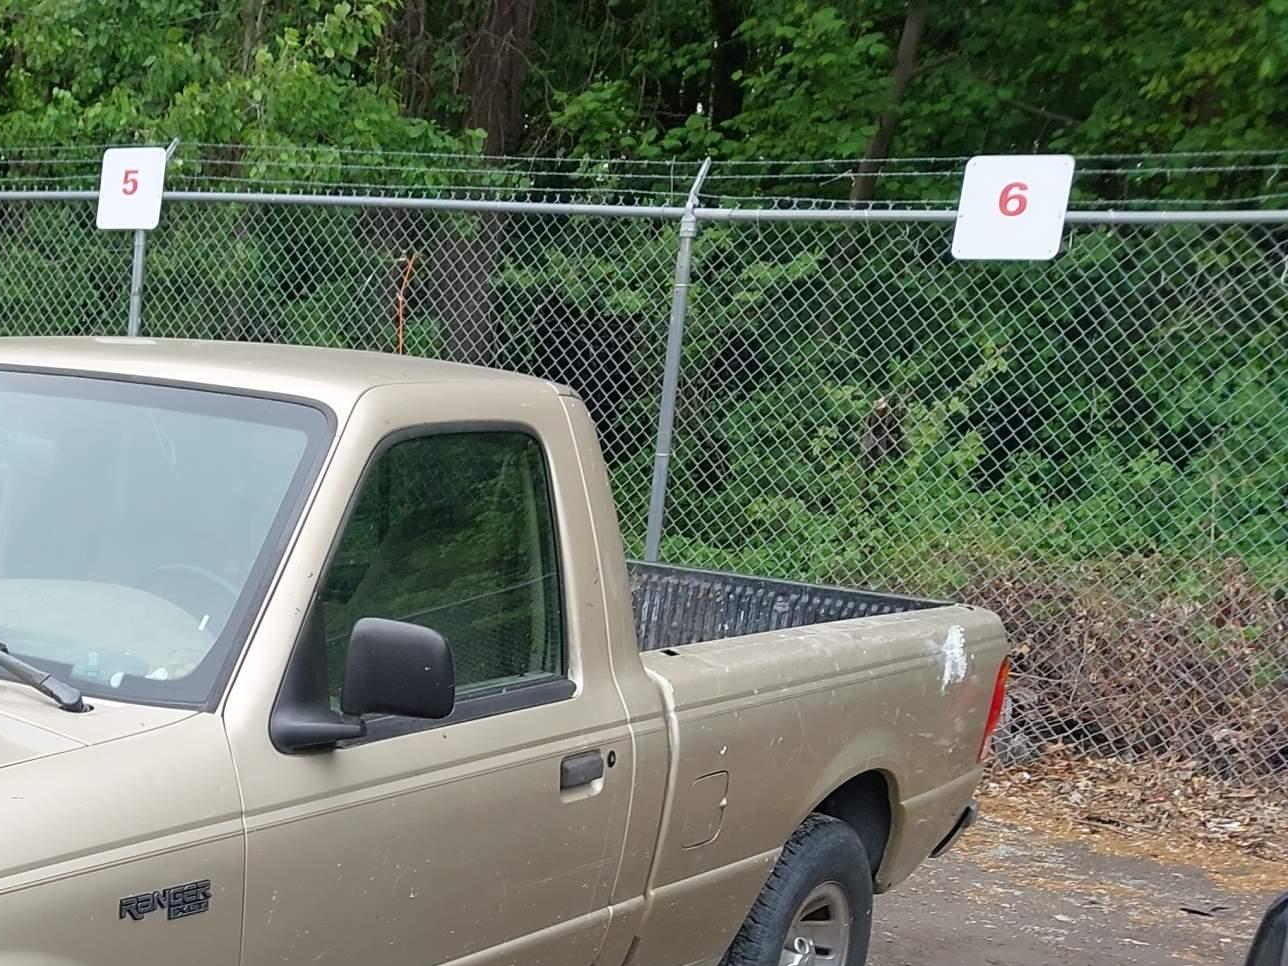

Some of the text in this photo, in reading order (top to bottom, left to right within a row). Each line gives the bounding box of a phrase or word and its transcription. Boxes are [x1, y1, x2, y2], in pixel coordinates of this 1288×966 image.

[122, 169, 139, 196] 5
[998, 181, 1029, 217] 6
[119, 879, 212, 921] RANGER
